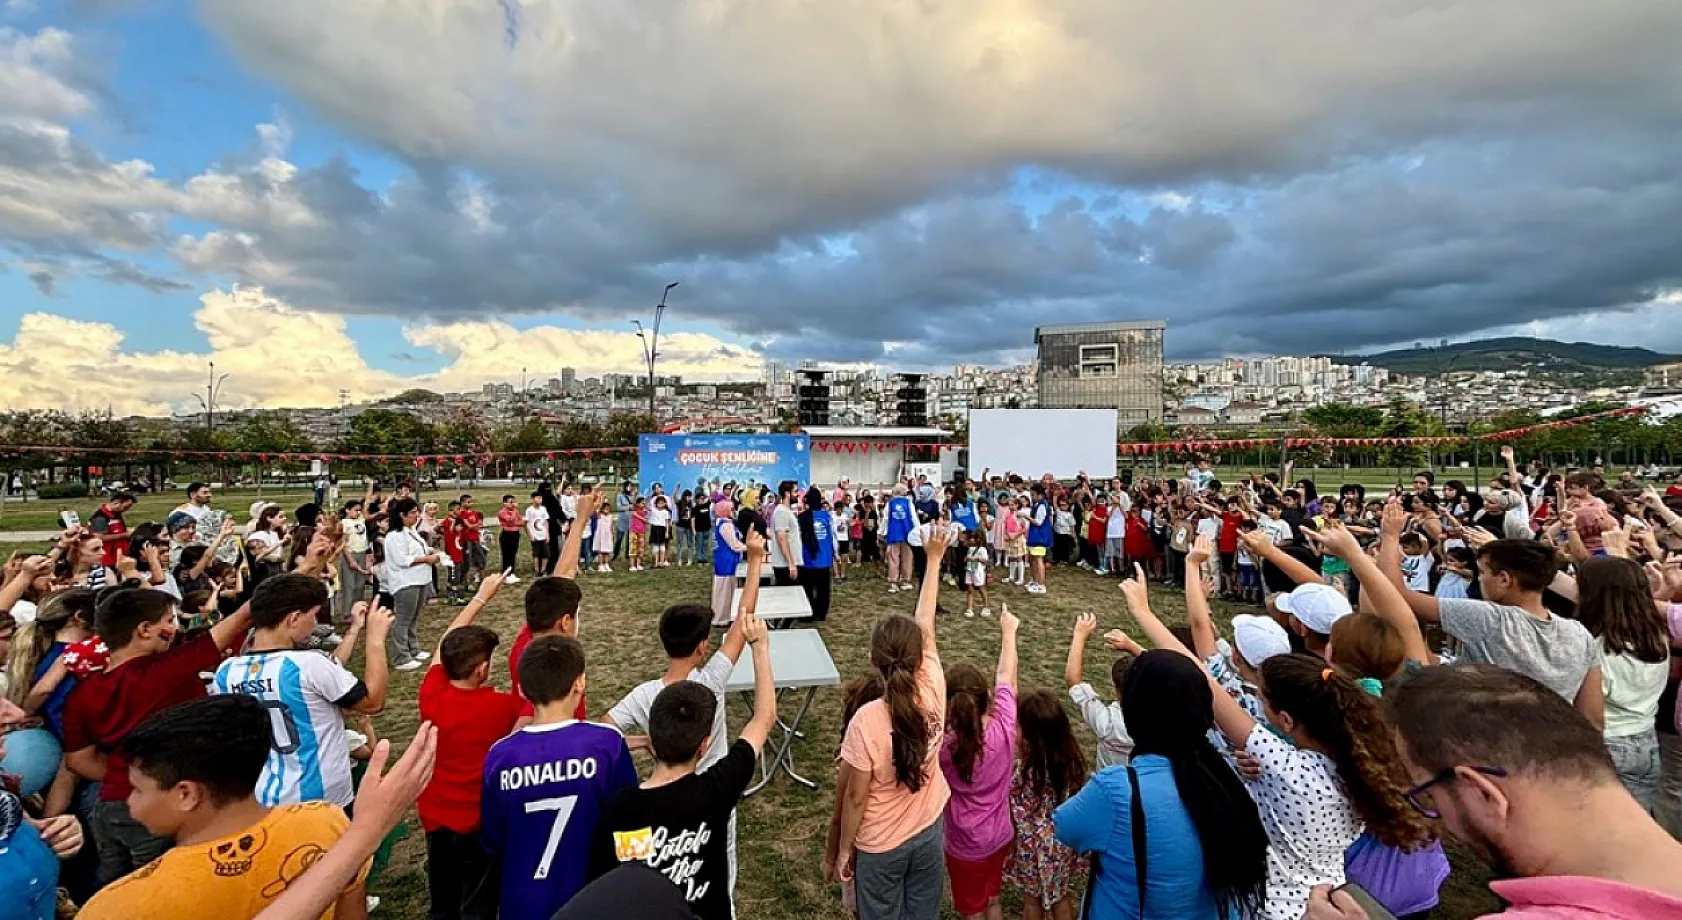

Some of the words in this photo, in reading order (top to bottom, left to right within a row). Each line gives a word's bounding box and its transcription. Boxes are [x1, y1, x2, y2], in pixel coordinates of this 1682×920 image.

[680, 452, 718, 466] ÇOCUK
[231, 678, 273, 694] MESSI
[500, 757, 597, 791] RONALDO
[524, 794, 579, 880] 7
